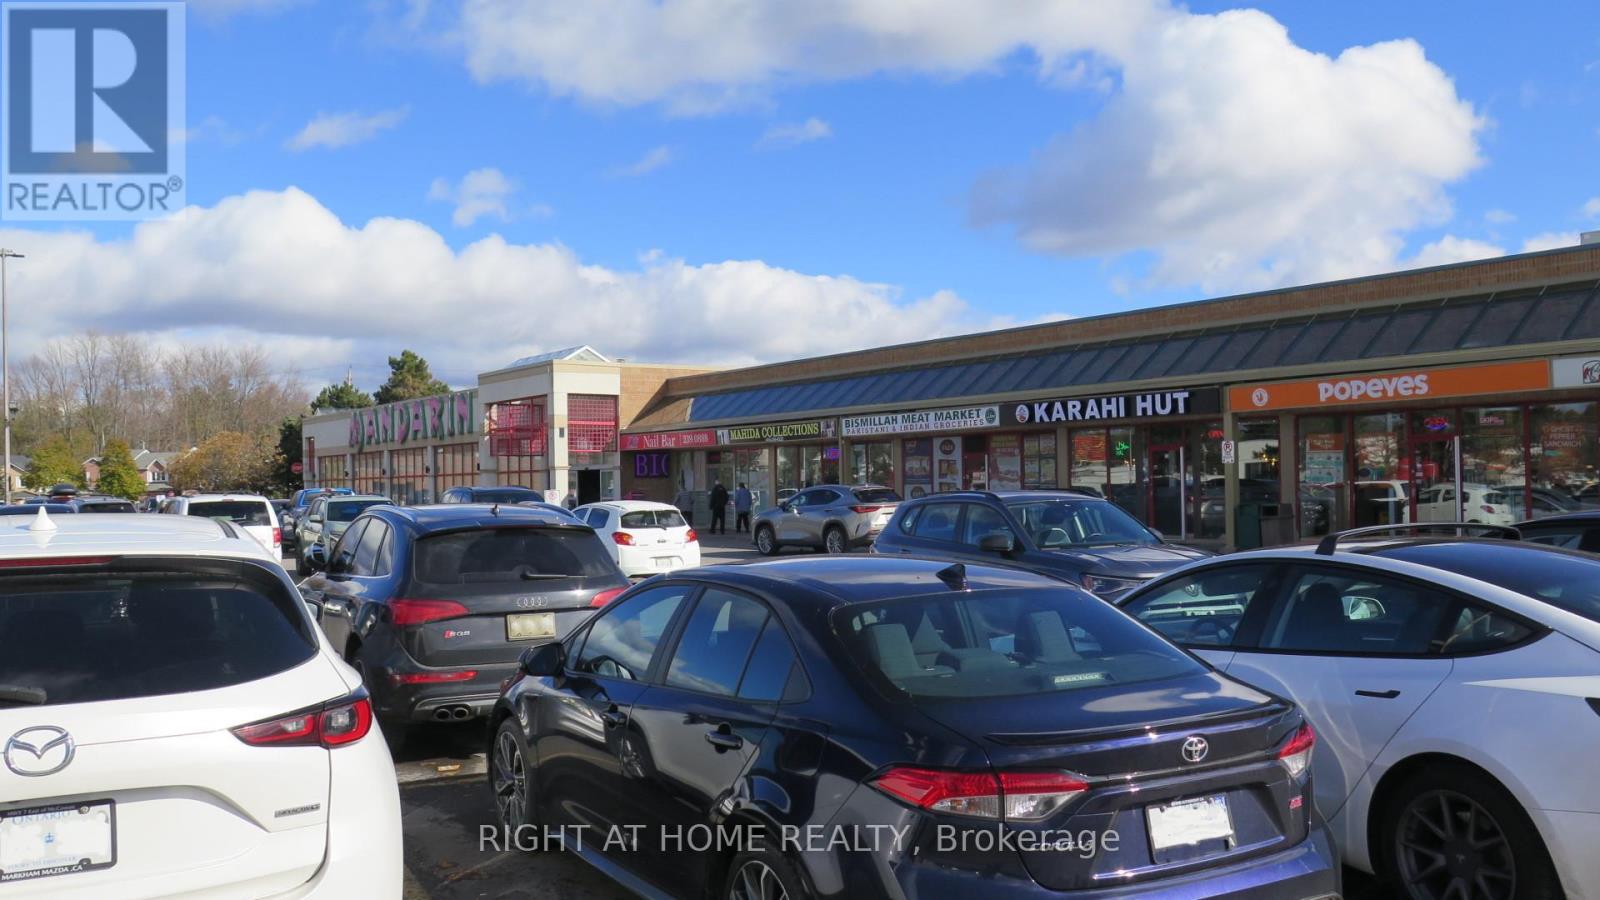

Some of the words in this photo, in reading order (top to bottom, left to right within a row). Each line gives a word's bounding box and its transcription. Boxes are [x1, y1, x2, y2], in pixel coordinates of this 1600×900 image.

[1034, 396, 1125, 423] KARAHI
[1135, 391, 1190, 416] HUT
[349, 391, 474, 453] MANDARIN
[845, 416, 898, 428] BISMILLAH
[901, 412, 930, 425] MEAT
[934, 408, 982, 422] MARKET
[846, 426, 889, 435] PAKISTANI
[900, 423, 930, 433] INDIAN
[933, 419, 985, 429] GROCERIES
[730, 428, 761, 440] MAHIDA
[761, 422, 820, 438] COLLECTIONS
[643, 433, 660, 449] Nail
[661, 433, 676, 448] Bar
[1, 871, 41, 881] MARKHAM
[41, 866, 69, 876] MAZDA
